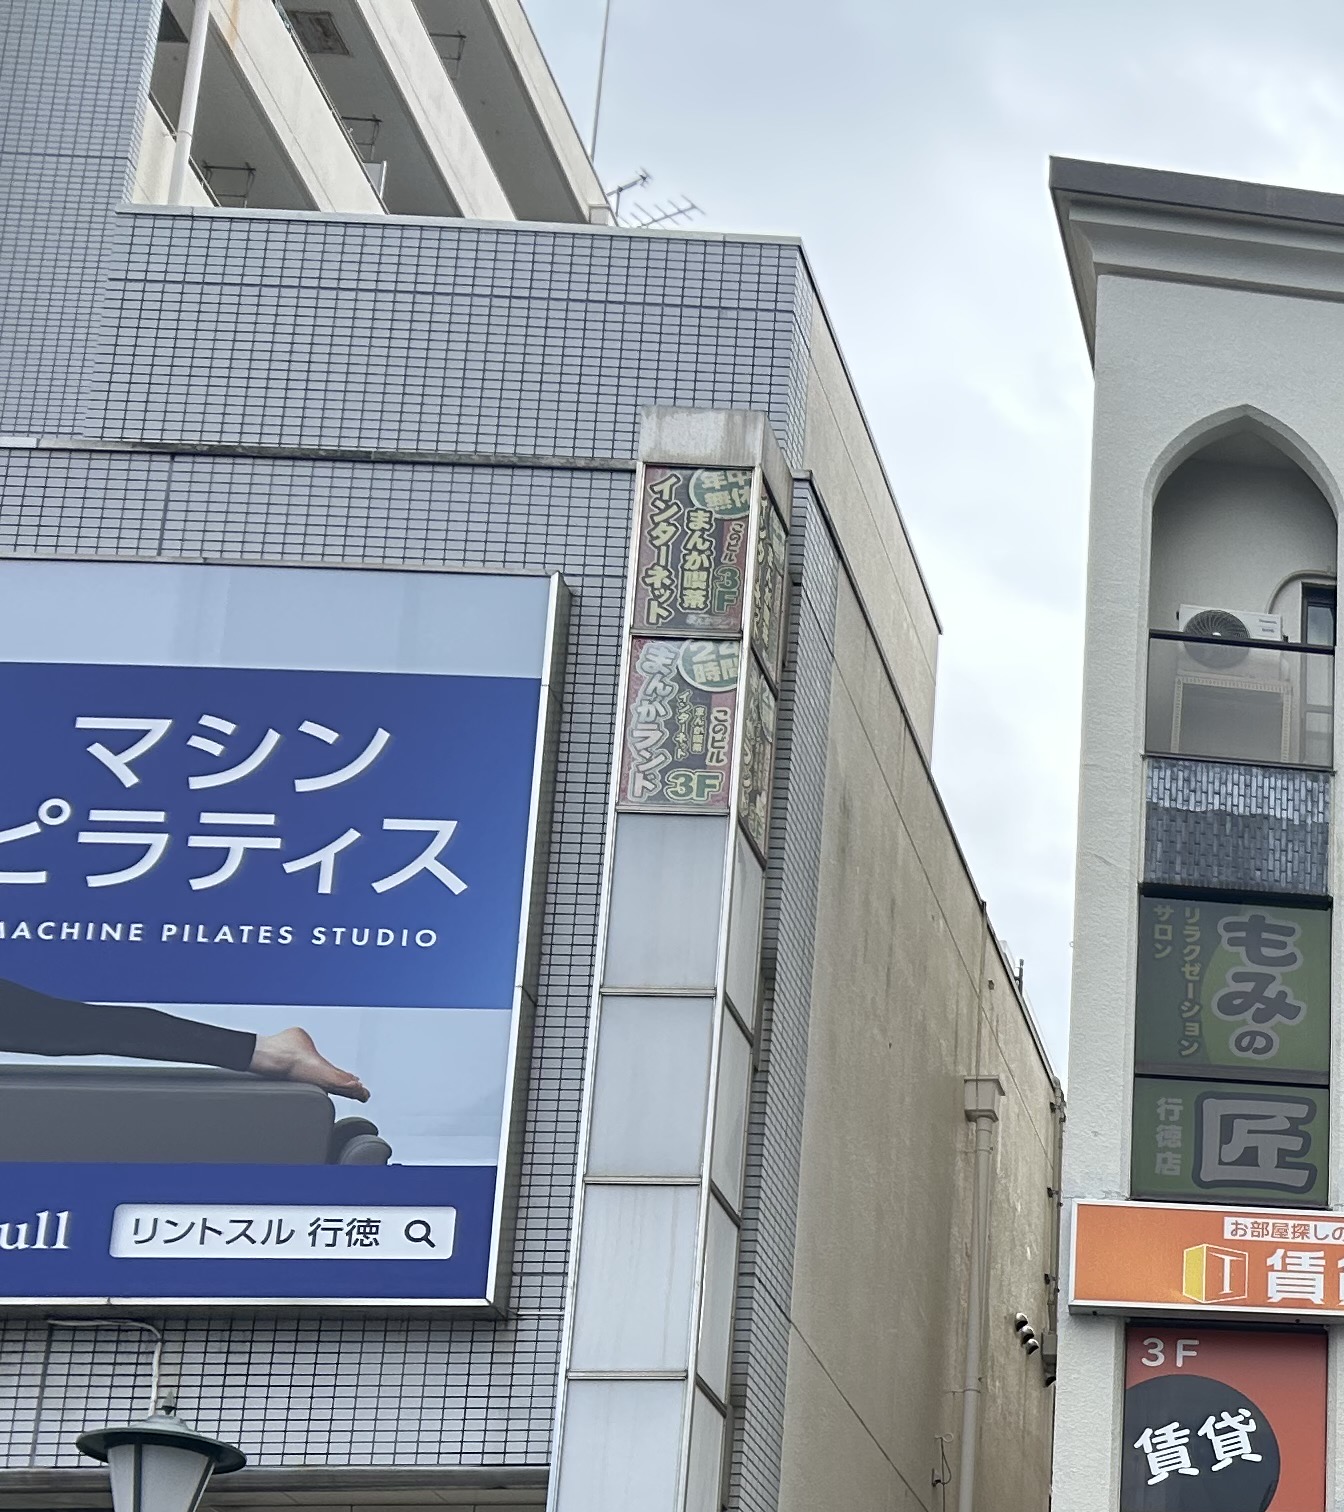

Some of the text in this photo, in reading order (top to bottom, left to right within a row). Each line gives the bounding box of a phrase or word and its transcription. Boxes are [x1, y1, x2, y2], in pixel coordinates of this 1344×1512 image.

[645, 475, 681, 624] インターネット
[75, 715, 391, 792] マシン
[631, 645, 676, 797] まんがランド
[709, 709, 728, 763] このビル
[667, 772, 721, 799] 3F
[0, 798, 468, 896] ピラティス
[161, 923, 293, 945] PILATES
[311, 926, 438, 948] STUDIO
[1153, 904, 1175, 959] サロン
[1180, 906, 1201, 1057] リラクゼーション
[1216, 914, 1302, 1056] もみの
[1155, 1097, 1185, 1176] 行徳店
[1198, 1096, 1313, 1189] 匠
[133, 1216, 382, 1249] リントスル 行徳
[1141, 1337, 1200, 1368] 3F
[1133, 1408, 1263, 1485] 賃貸
